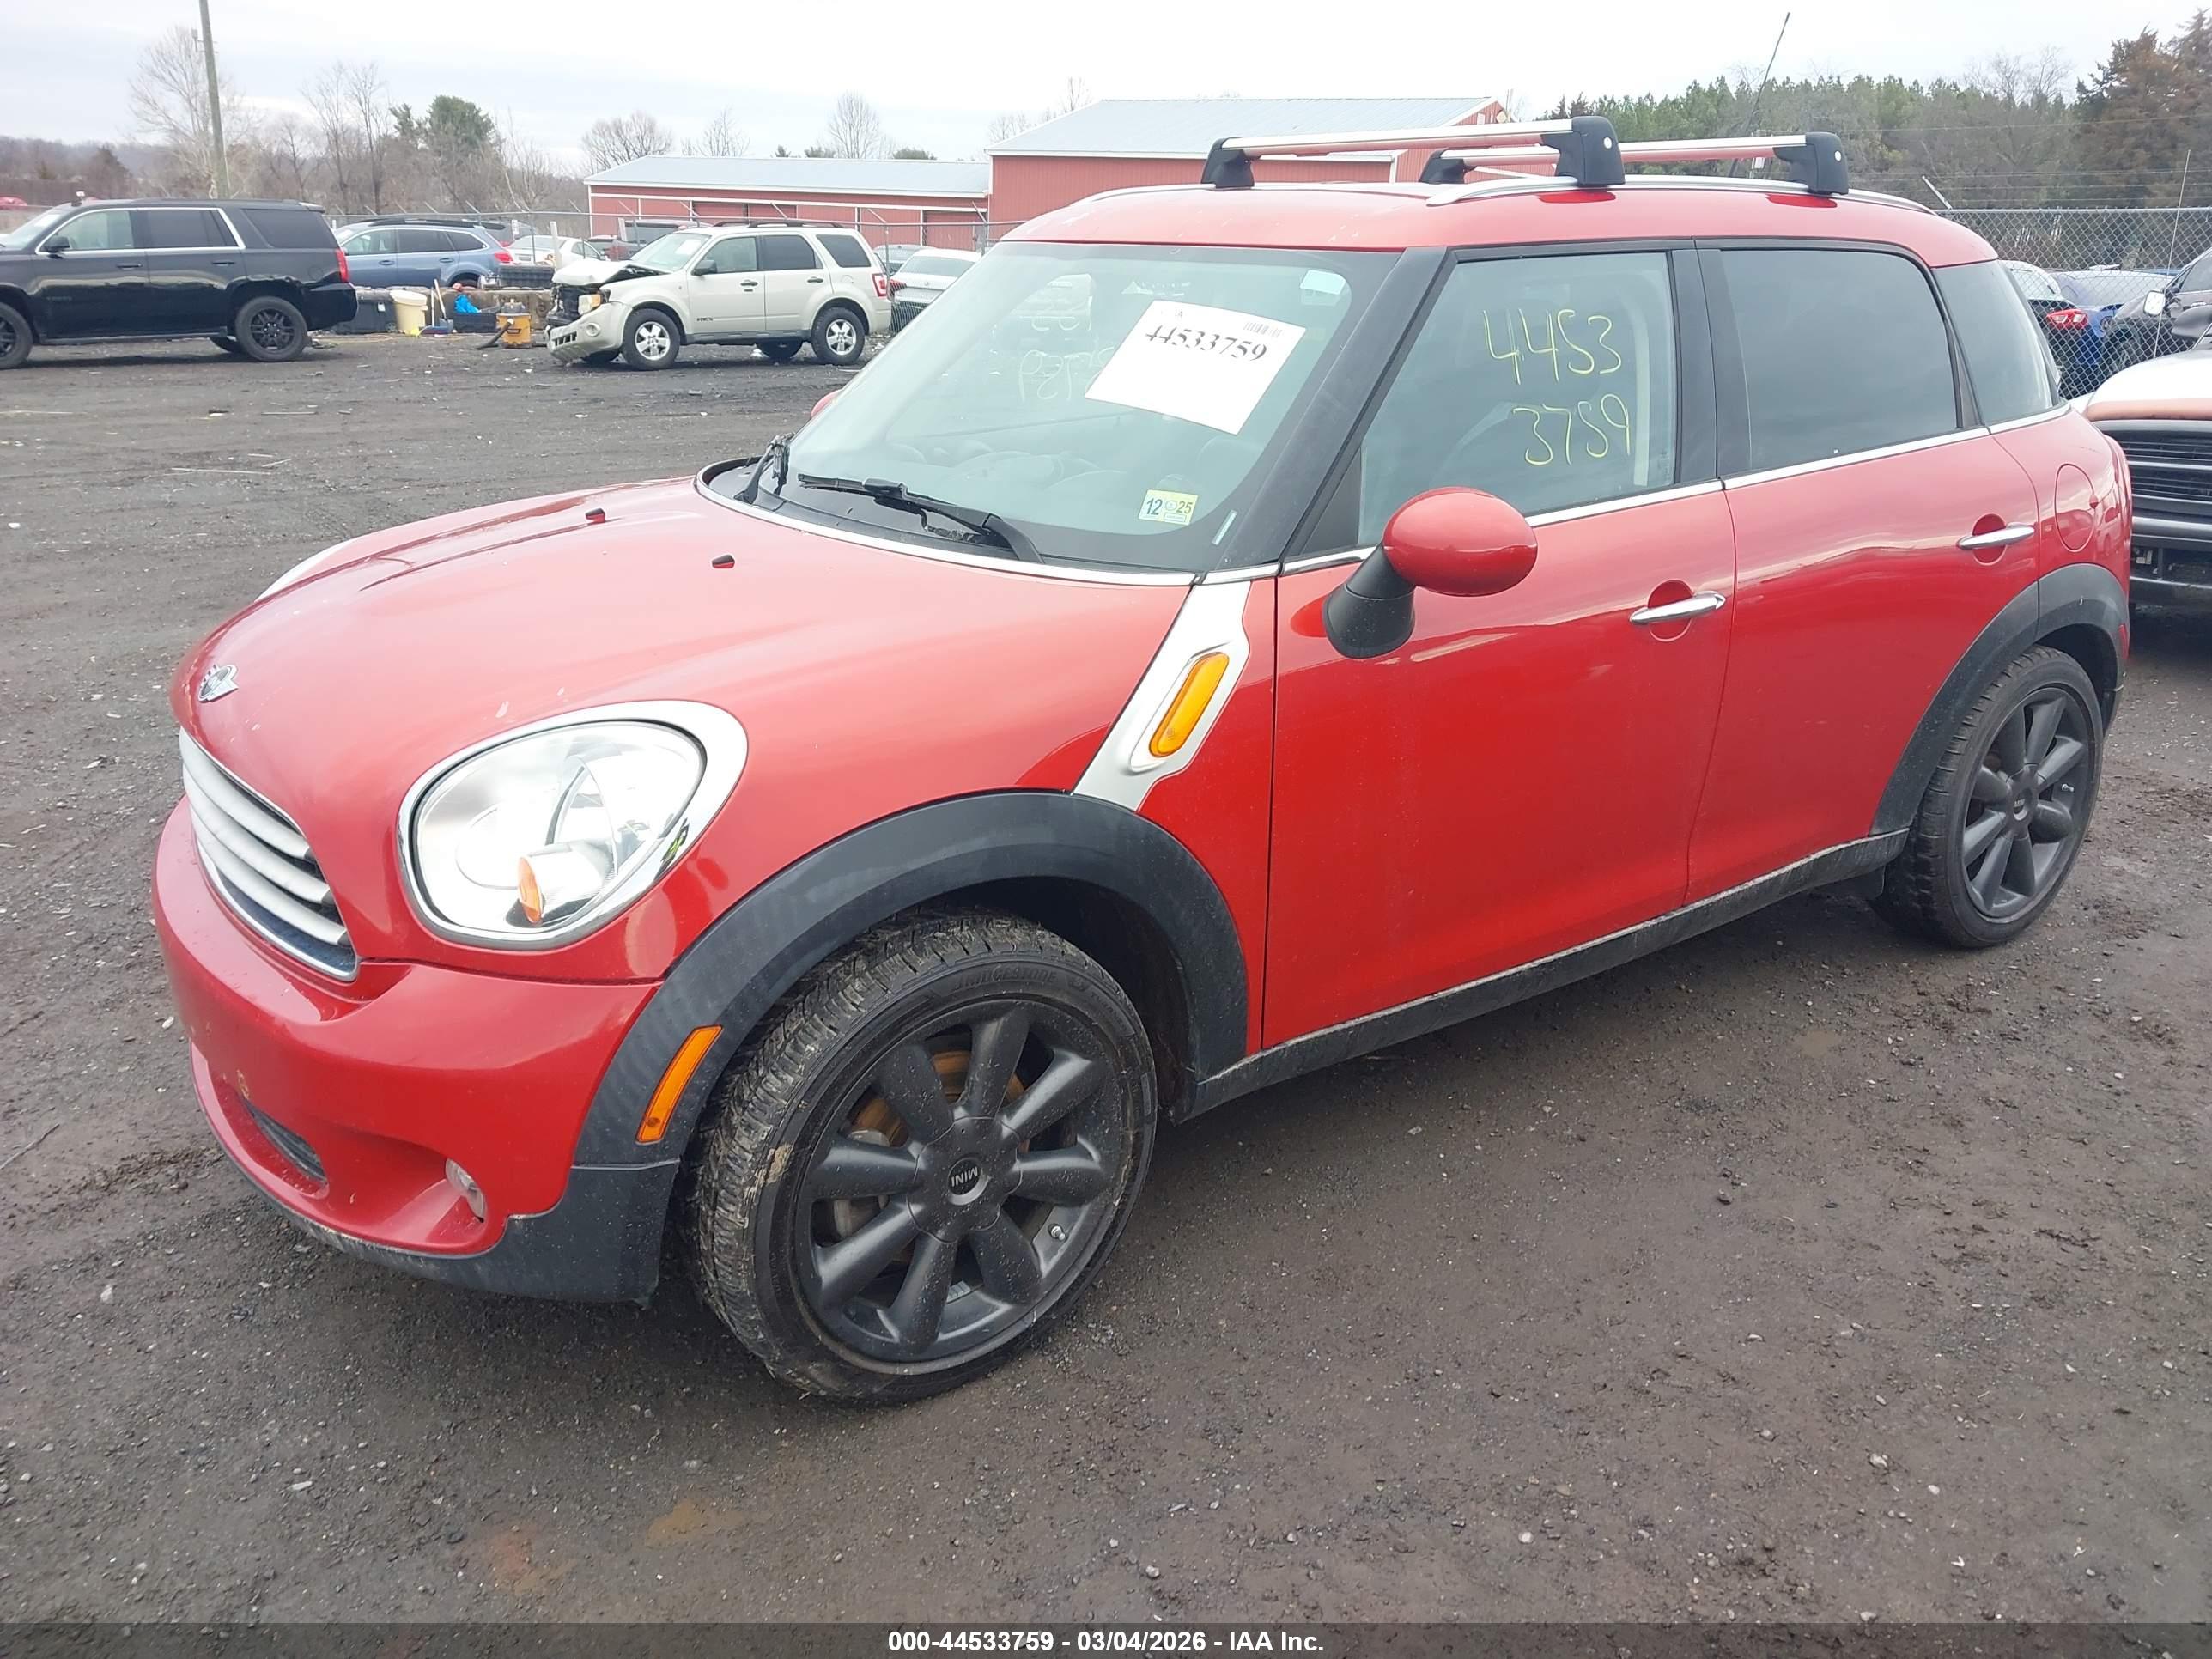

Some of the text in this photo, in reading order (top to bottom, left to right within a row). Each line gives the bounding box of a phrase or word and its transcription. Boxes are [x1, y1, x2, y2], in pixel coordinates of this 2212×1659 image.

[1145, 324, 1268, 362] 44533759
[1483, 308, 1622, 386] 4453
[1512, 392, 1631, 465] 3759
[1146, 497, 1194, 516] 12 25
[951, 1166, 978, 1188] MINI
